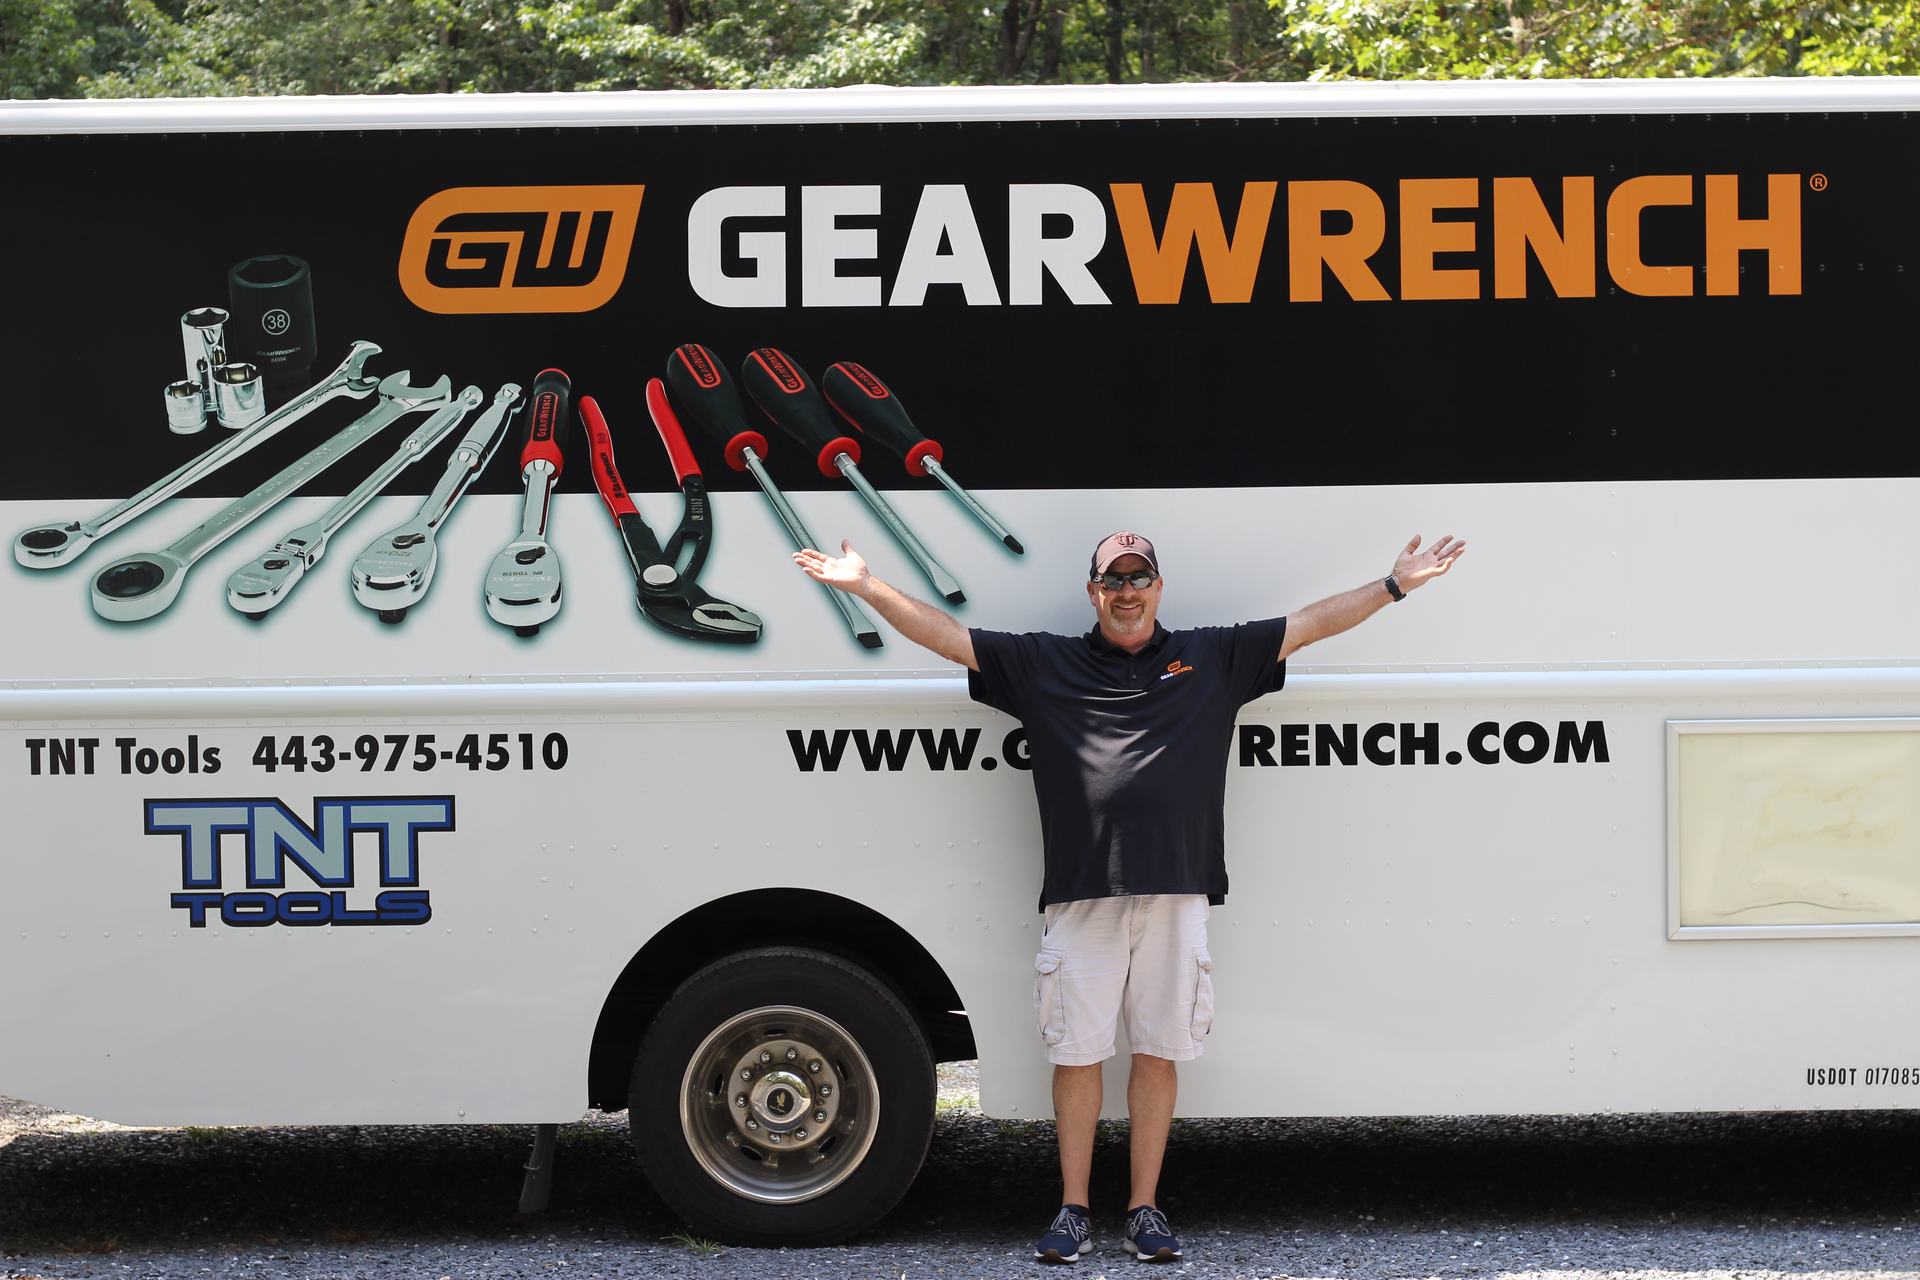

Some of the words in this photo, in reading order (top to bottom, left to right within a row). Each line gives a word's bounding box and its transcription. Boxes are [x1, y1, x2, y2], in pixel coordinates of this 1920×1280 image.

[425, 211, 613, 288] GW
[267, 313, 286, 331] 38
[256, 346, 301, 357] GEARWRENCH
[685, 344, 714, 384] GEARWRENC
[761, 348, 798, 389] GEARWRENC
[537, 394, 552, 438] GEARWRENCH
[600, 452, 621, 492] GEARWRENCH
[26, 738, 99, 775] TNT
[115, 735, 221, 774] Tools
[253, 733, 568, 772] 443-975-4510
[786, 721, 1609, 771] WWW.GRENCH.COM
[143, 795, 456, 890] TNT
[171, 889, 432, 928] TOOLS
[1807, 1068, 1857, 1085] USDOT
[1865, 1067, 1920, 1085] 017085
